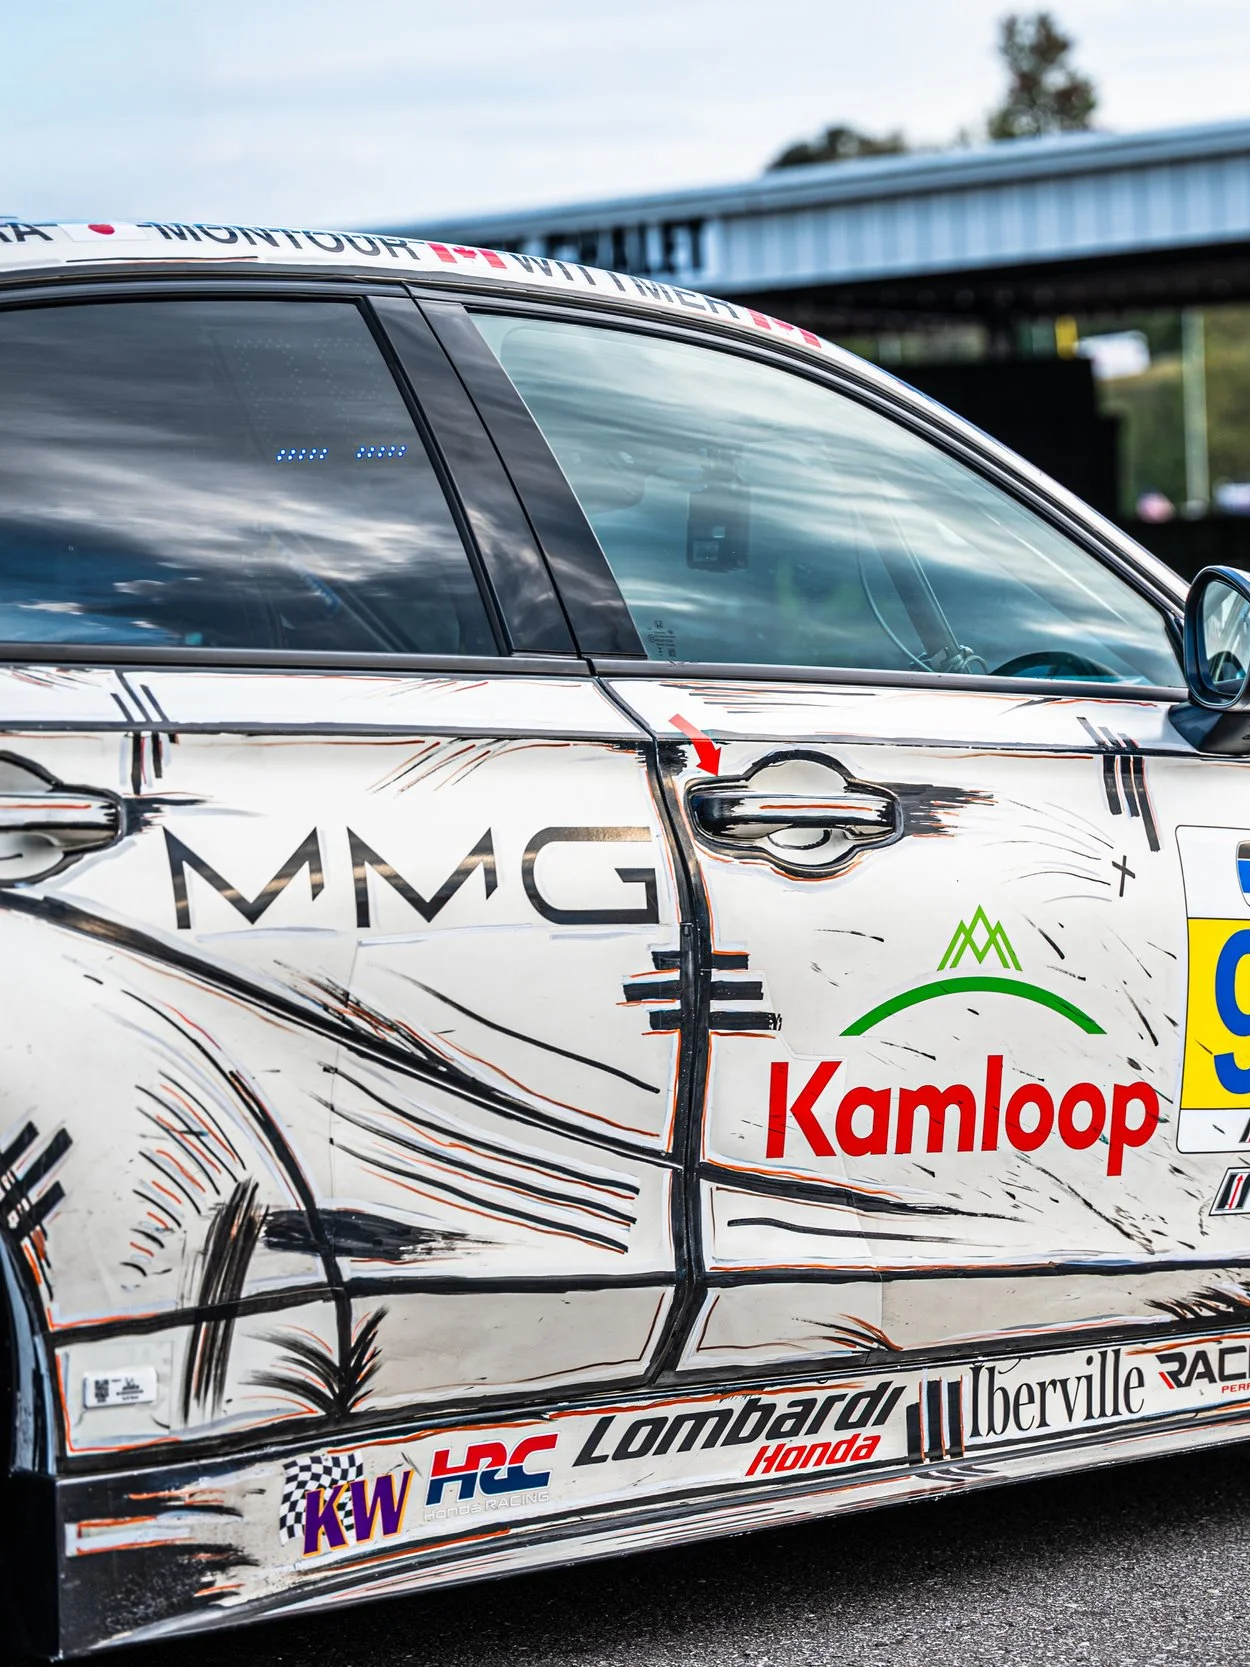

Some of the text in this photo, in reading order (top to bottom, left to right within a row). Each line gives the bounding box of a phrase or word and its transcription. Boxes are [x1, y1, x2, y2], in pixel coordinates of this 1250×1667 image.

[148, 221, 421, 260] MONTOUR
[162, 826, 660, 930] MMG
[765, 1054, 1160, 1177] Kamloop
[572, 1381, 907, 1467] Lombardi
[969, 1348, 1146, 1439] Iberville
[425, 1432, 560, 1508] HRC
[745, 1432, 882, 1477] Honda
[302, 1467, 415, 1558] KW
[423, 1490, 550, 1521] Honda RACING
